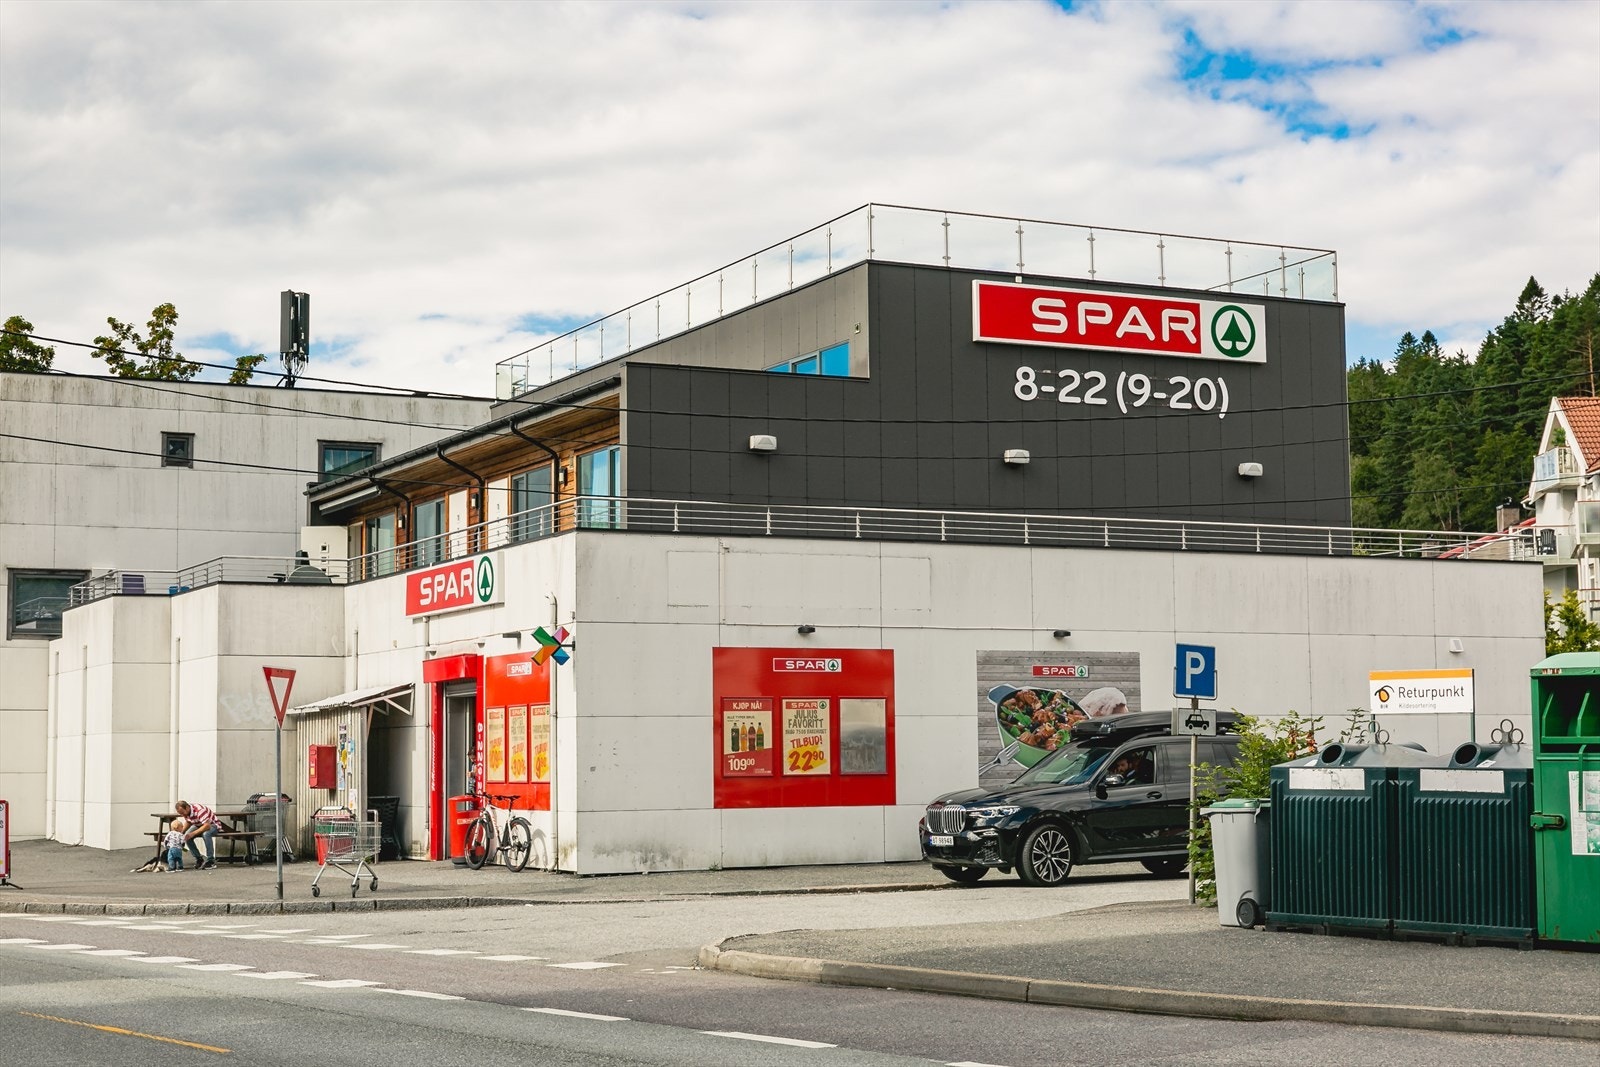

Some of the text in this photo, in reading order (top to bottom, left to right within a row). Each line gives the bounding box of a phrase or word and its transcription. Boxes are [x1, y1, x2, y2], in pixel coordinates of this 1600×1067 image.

[1032, 297, 1197, 344] SPAR
[1014, 366, 1229, 418] 8-22 (9-20)
[420, 567, 473, 606] SPAR
[511, 664, 526, 674] SPAR
[786, 660, 824, 669] SPAR
[1185, 651, 1205, 689] P
[1042, 667, 1075, 675] SPAR
[1398, 685, 1465, 700] Returpunkt
[733, 701, 762, 710] KJØP NÅ!
[794, 710, 818, 719] JULIUS
[788, 719, 823, 728] FAVORITT
[790, 735, 823, 748] TILBUD!
